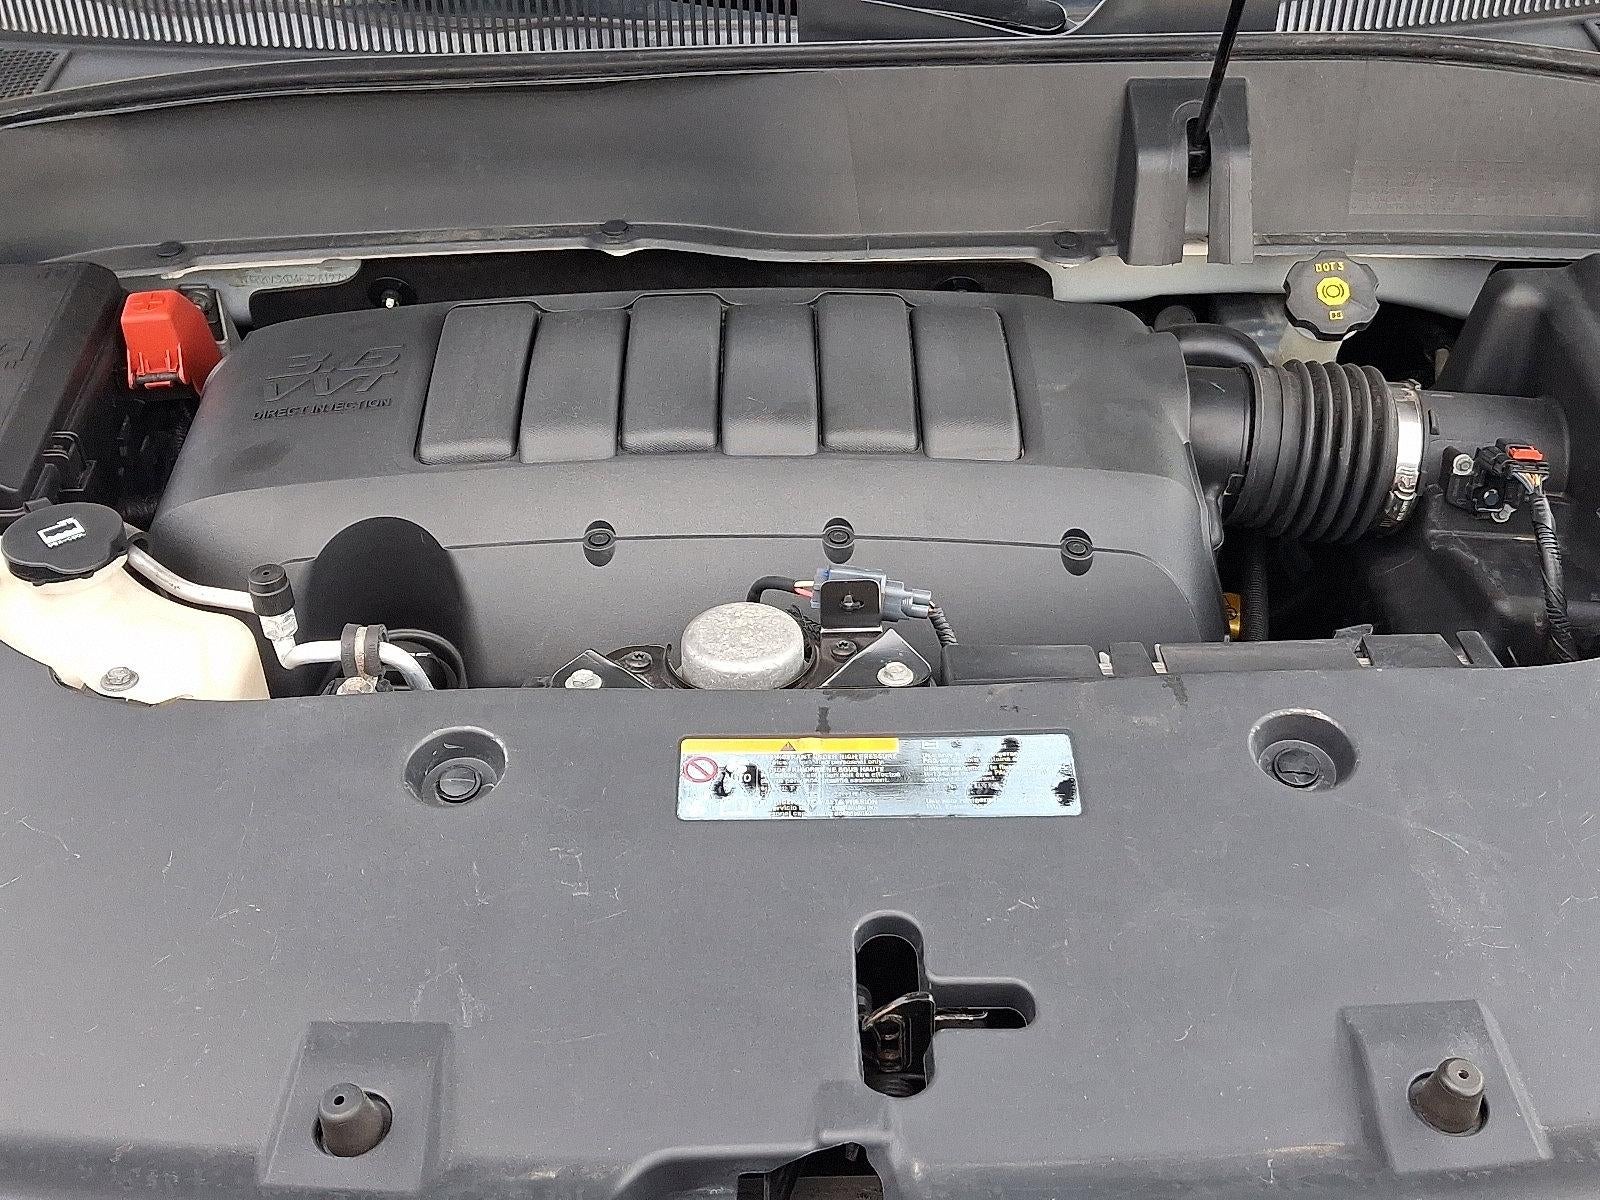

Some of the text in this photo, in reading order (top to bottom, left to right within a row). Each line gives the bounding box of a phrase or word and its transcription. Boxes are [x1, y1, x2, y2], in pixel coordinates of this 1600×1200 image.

[1315, 261, 1344, 272] DOT 3
[264, 371, 398, 403] VVT
[253, 398, 392, 420] DIRECT INJECTION
